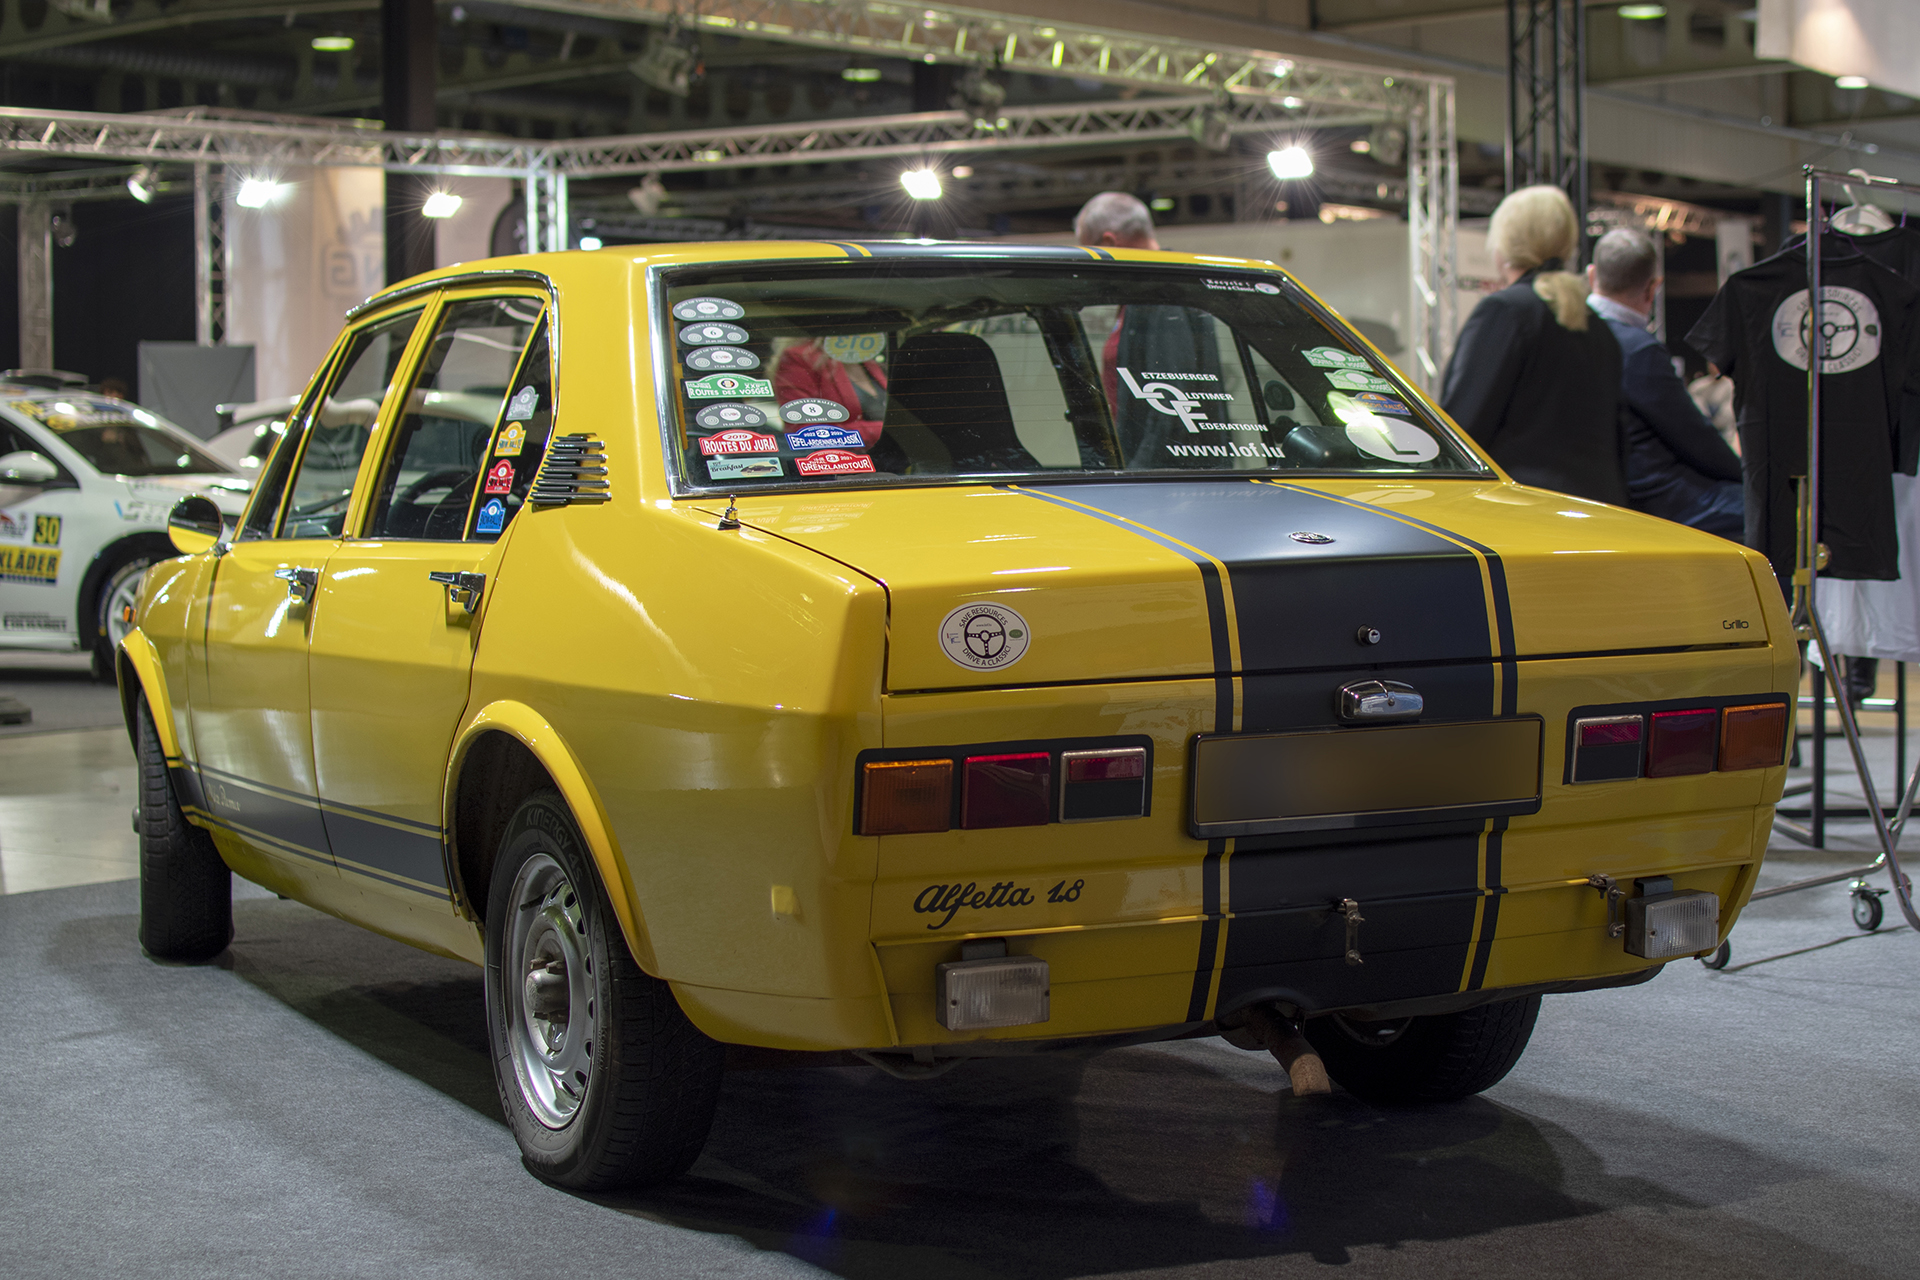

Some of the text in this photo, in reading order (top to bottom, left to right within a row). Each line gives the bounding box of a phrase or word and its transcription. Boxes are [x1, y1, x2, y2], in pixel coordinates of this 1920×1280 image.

[690, 387, 719, 396] ROUTES
[739, 386, 770, 395] VOSGES
[703, 438, 776, 453] ROUTES DU JURA
[1166, 442, 1286, 459] www.lof.lu
[710, 463, 744, 473] Breakfast
[800, 459, 871, 471] GRENZLANDTOUR
[35, 515, 60, 545] 30
[959, 607, 1009, 629] SAVE RESOURCES
[1722, 620, 1750, 630] Grillo
[962, 647, 980, 665] DRIVE
